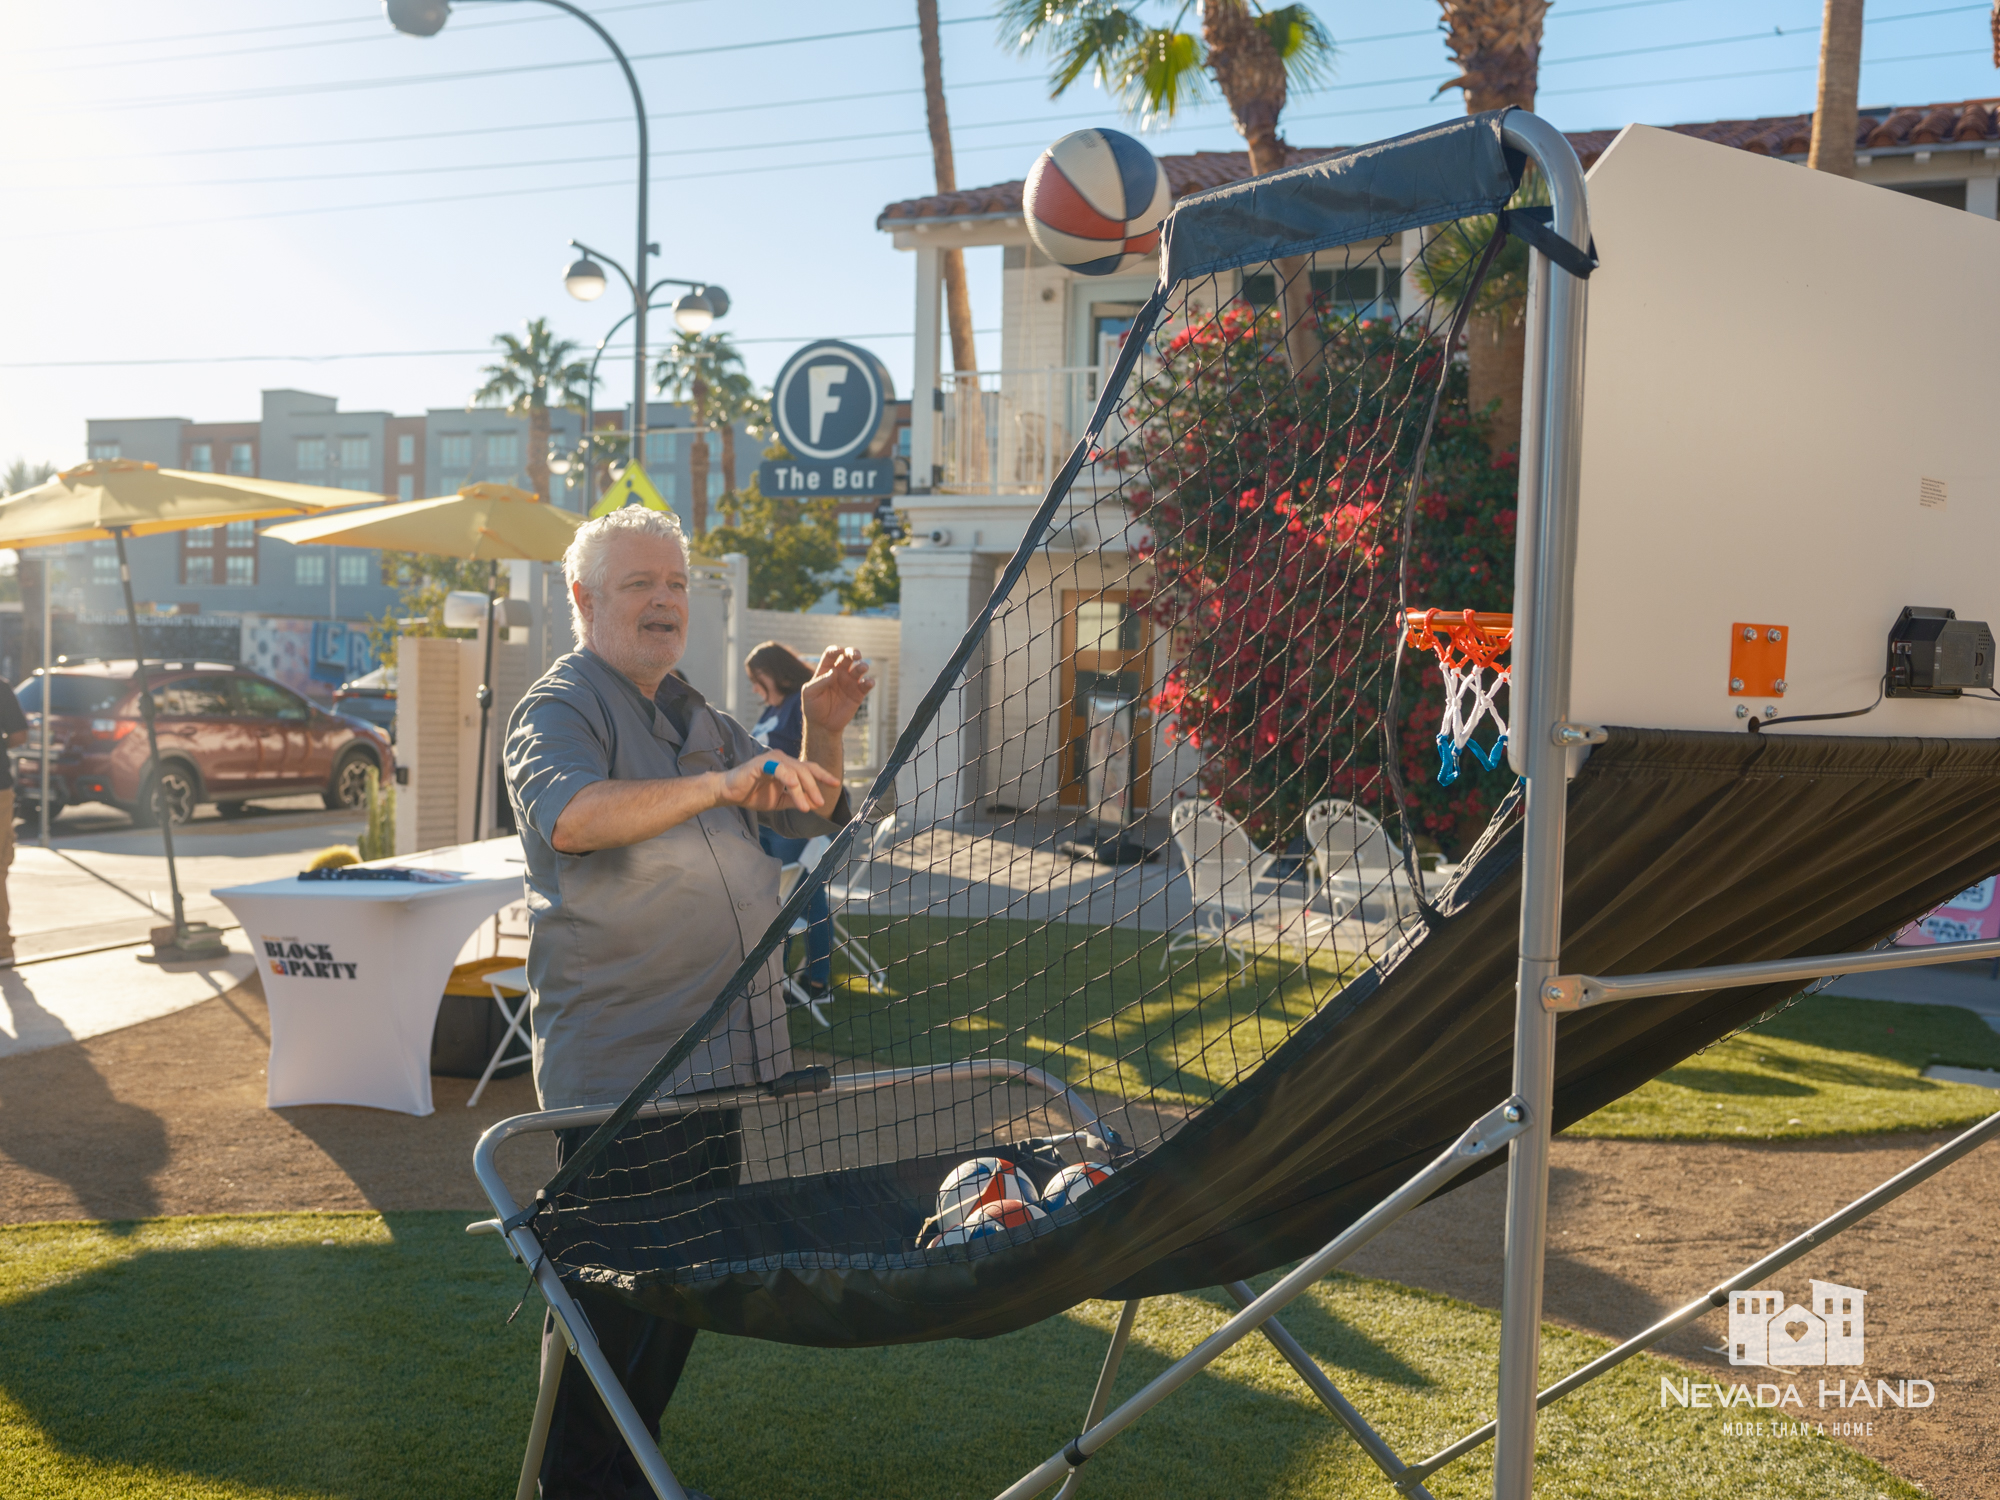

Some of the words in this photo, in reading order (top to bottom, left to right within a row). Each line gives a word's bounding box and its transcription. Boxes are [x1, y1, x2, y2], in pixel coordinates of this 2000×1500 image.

[808, 364, 849, 445] F
[775, 466, 821, 490] The
[833, 467, 877, 490] Bar
[264, 941, 333, 961] BLOCK
[288, 960, 357, 979] PARTY
